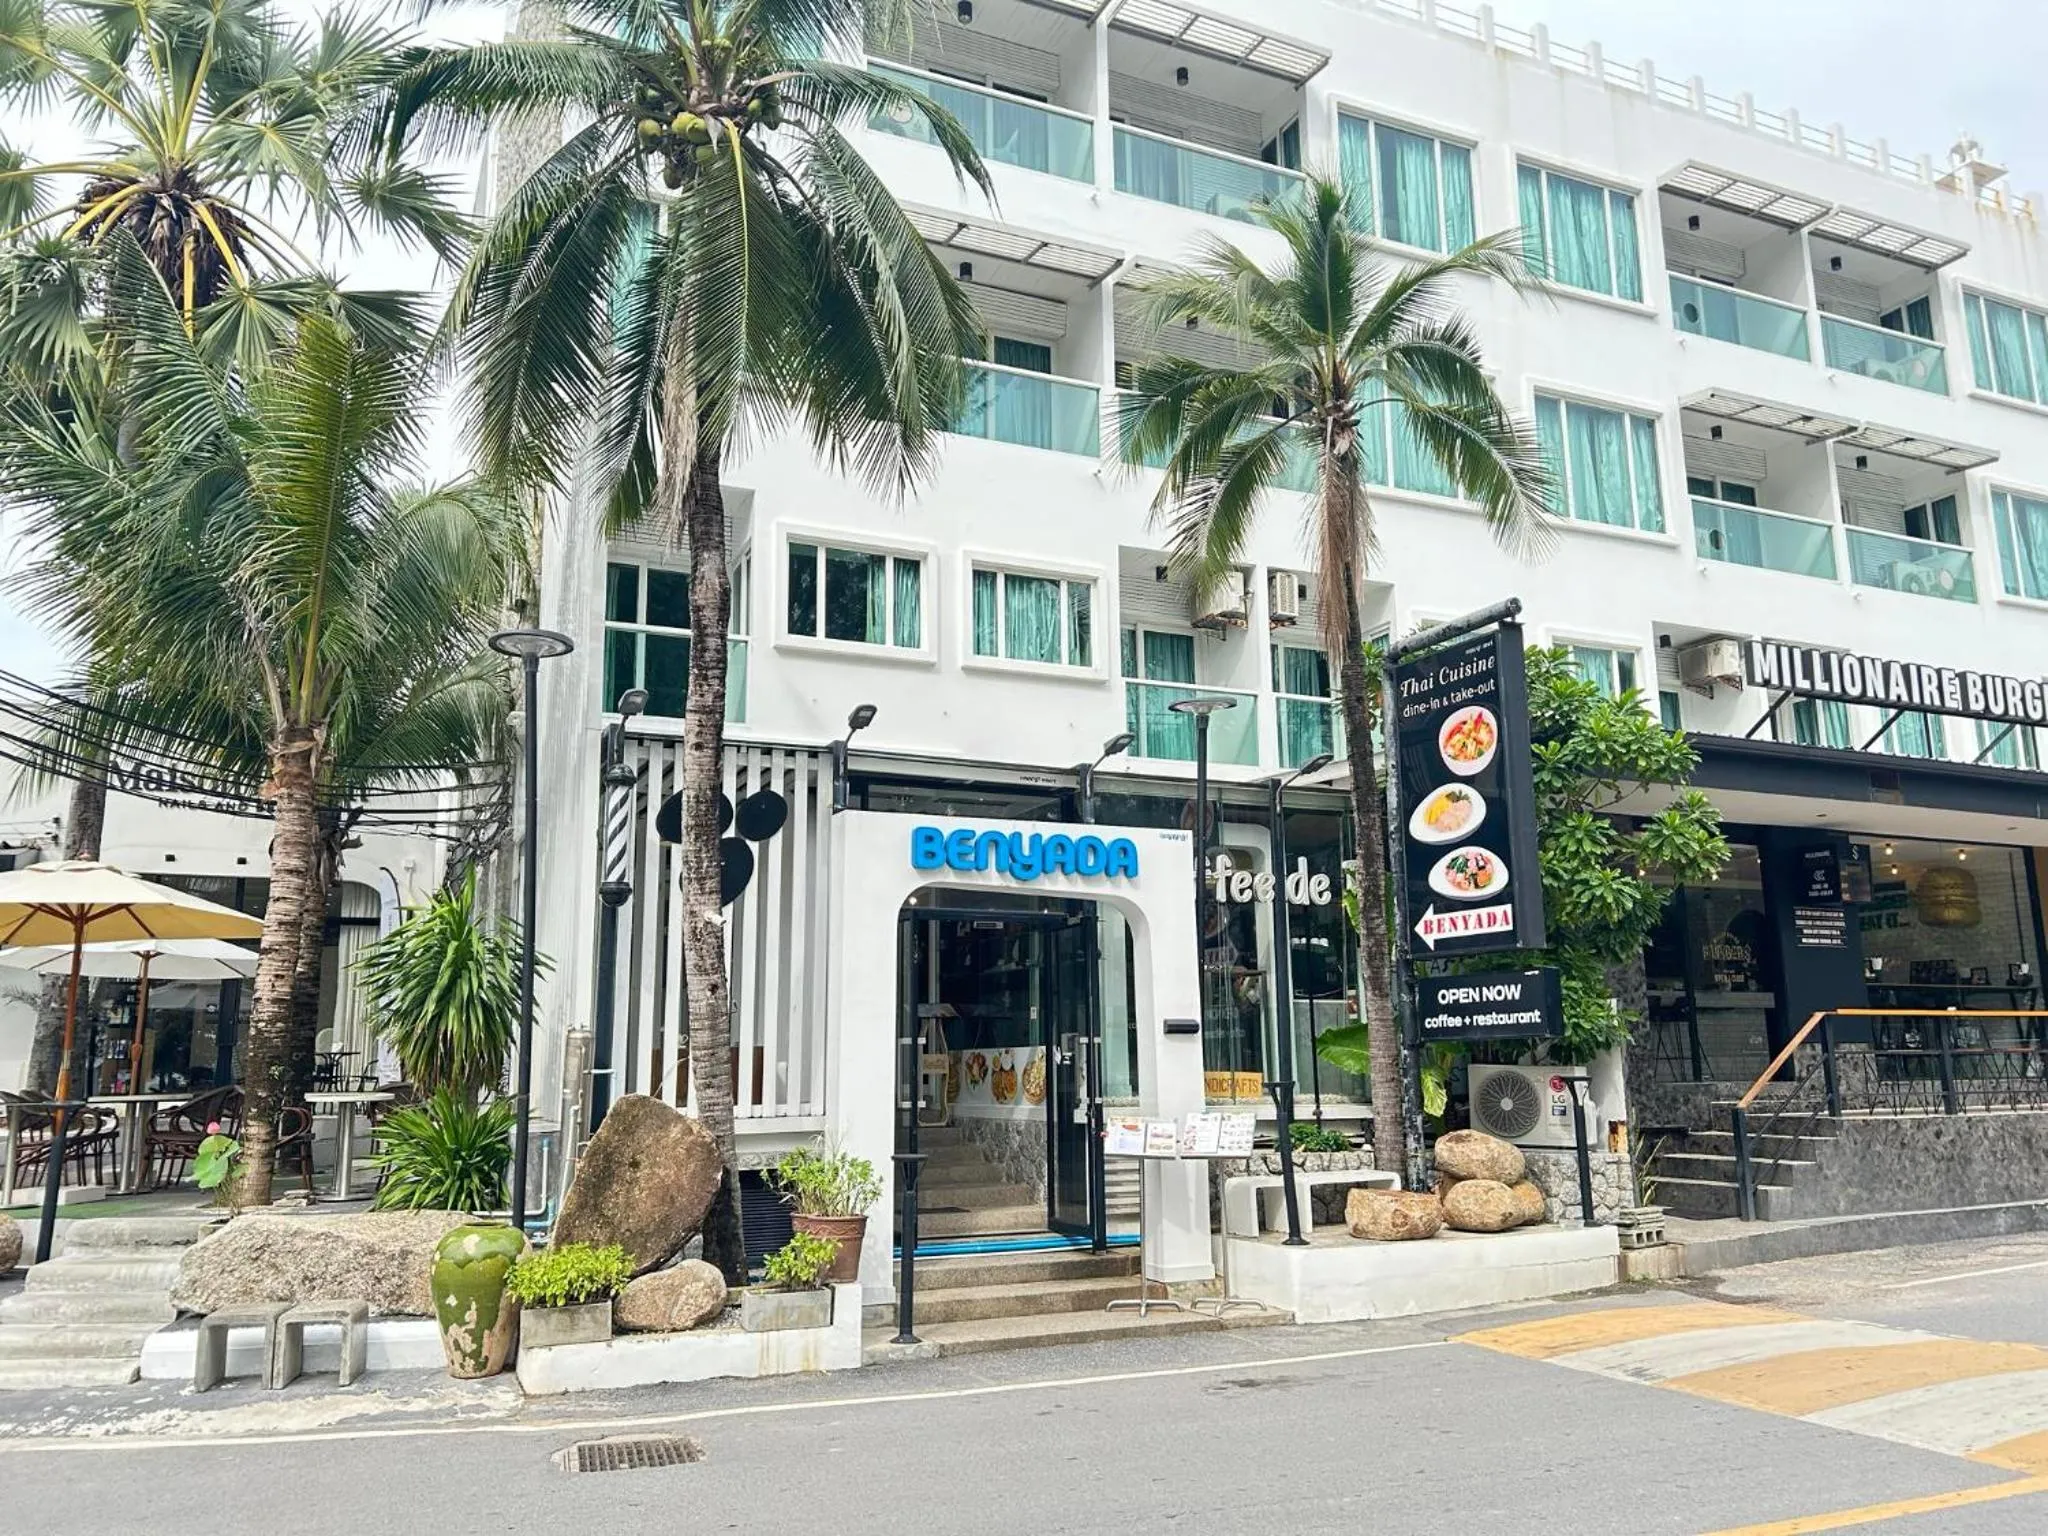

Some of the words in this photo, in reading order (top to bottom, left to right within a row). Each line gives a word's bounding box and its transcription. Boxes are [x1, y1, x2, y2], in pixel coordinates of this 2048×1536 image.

[1400, 672, 1434, 698] Thai
[1439, 655, 1496, 685] Cuisine
[1750, 640, 1960, 711] MILLIONAIRE
[1403, 698, 1440, 718] dine-in
[1442, 695, 1448, 706] &
[1450, 678, 1496, 704] take-out
[1286, 856, 1332, 905] de
[1423, 909, 1511, 935] BENYADA
[1438, 986, 1480, 1004] OPEN
[1482, 984, 1521, 1002] NOW
[1425, 1013, 1462, 1029] coffee
[1473, 1009, 1541, 1027] restaurant
[1551, 1094, 1566, 1104] LG
